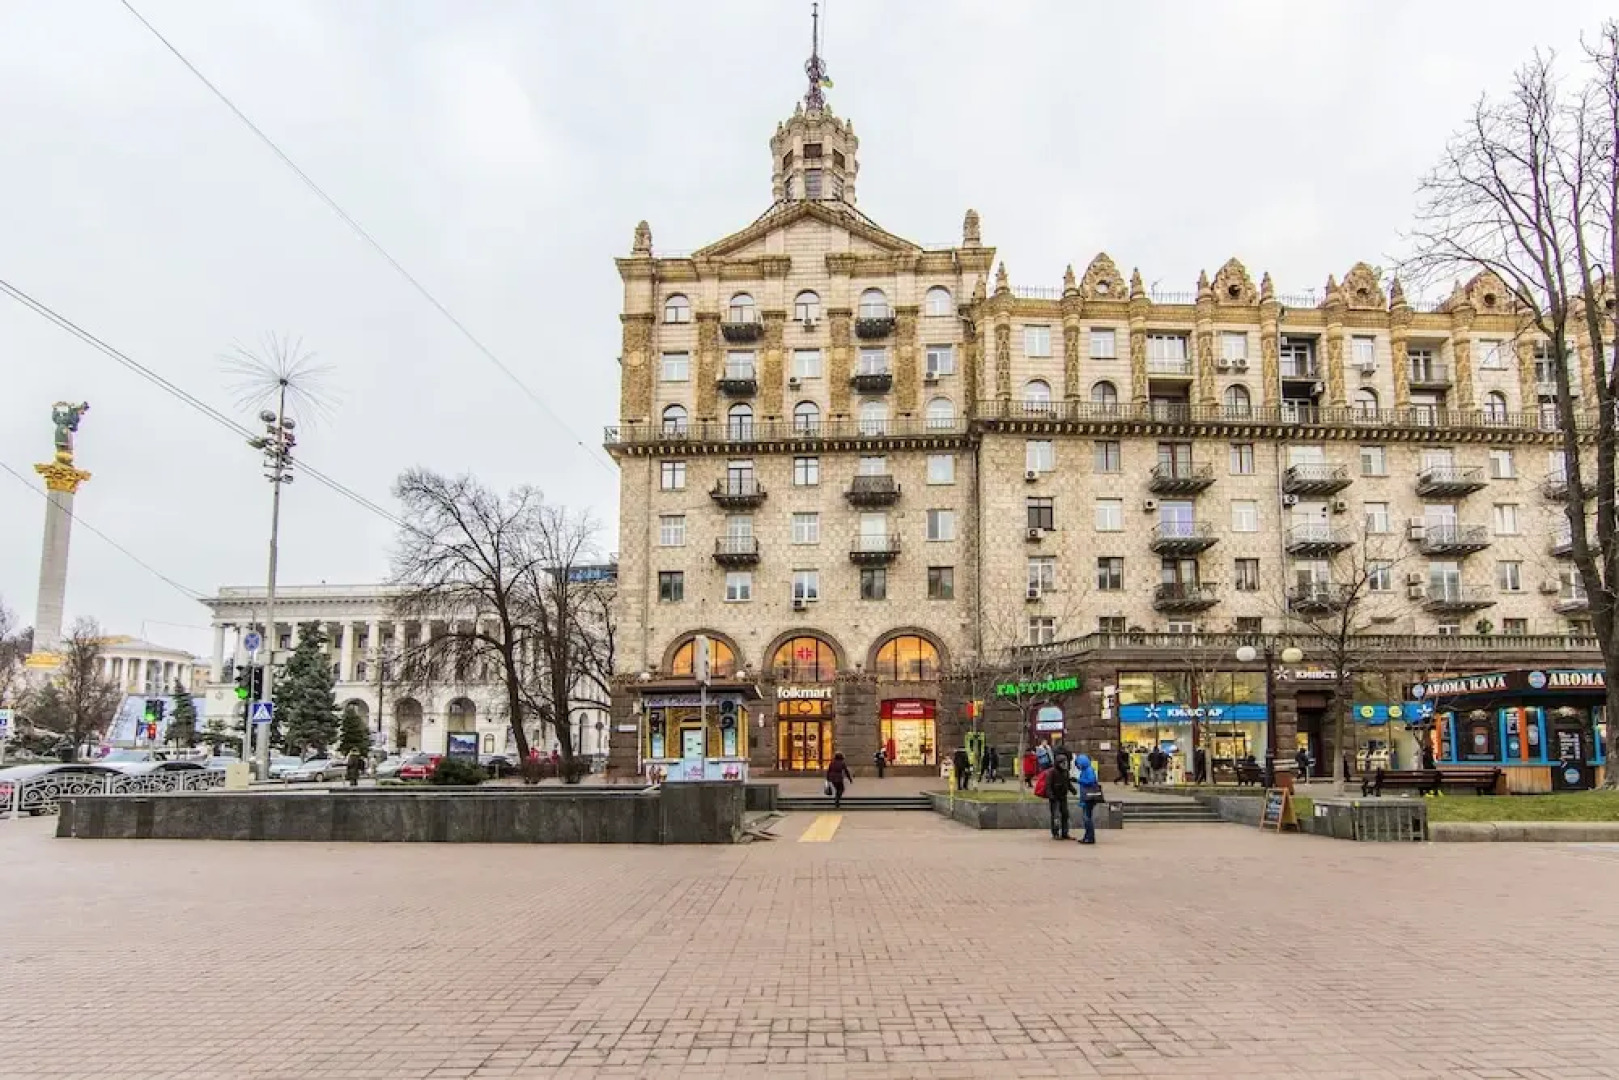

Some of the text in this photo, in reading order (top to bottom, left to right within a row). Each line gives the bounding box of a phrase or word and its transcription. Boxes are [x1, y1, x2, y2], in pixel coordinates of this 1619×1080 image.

[1426, 680, 1467, 694] AROMA
[1469, 675, 1507, 690] KAVA
[1548, 672, 1605, 686] AROMA
[777, 686, 833, 699] folkmart
